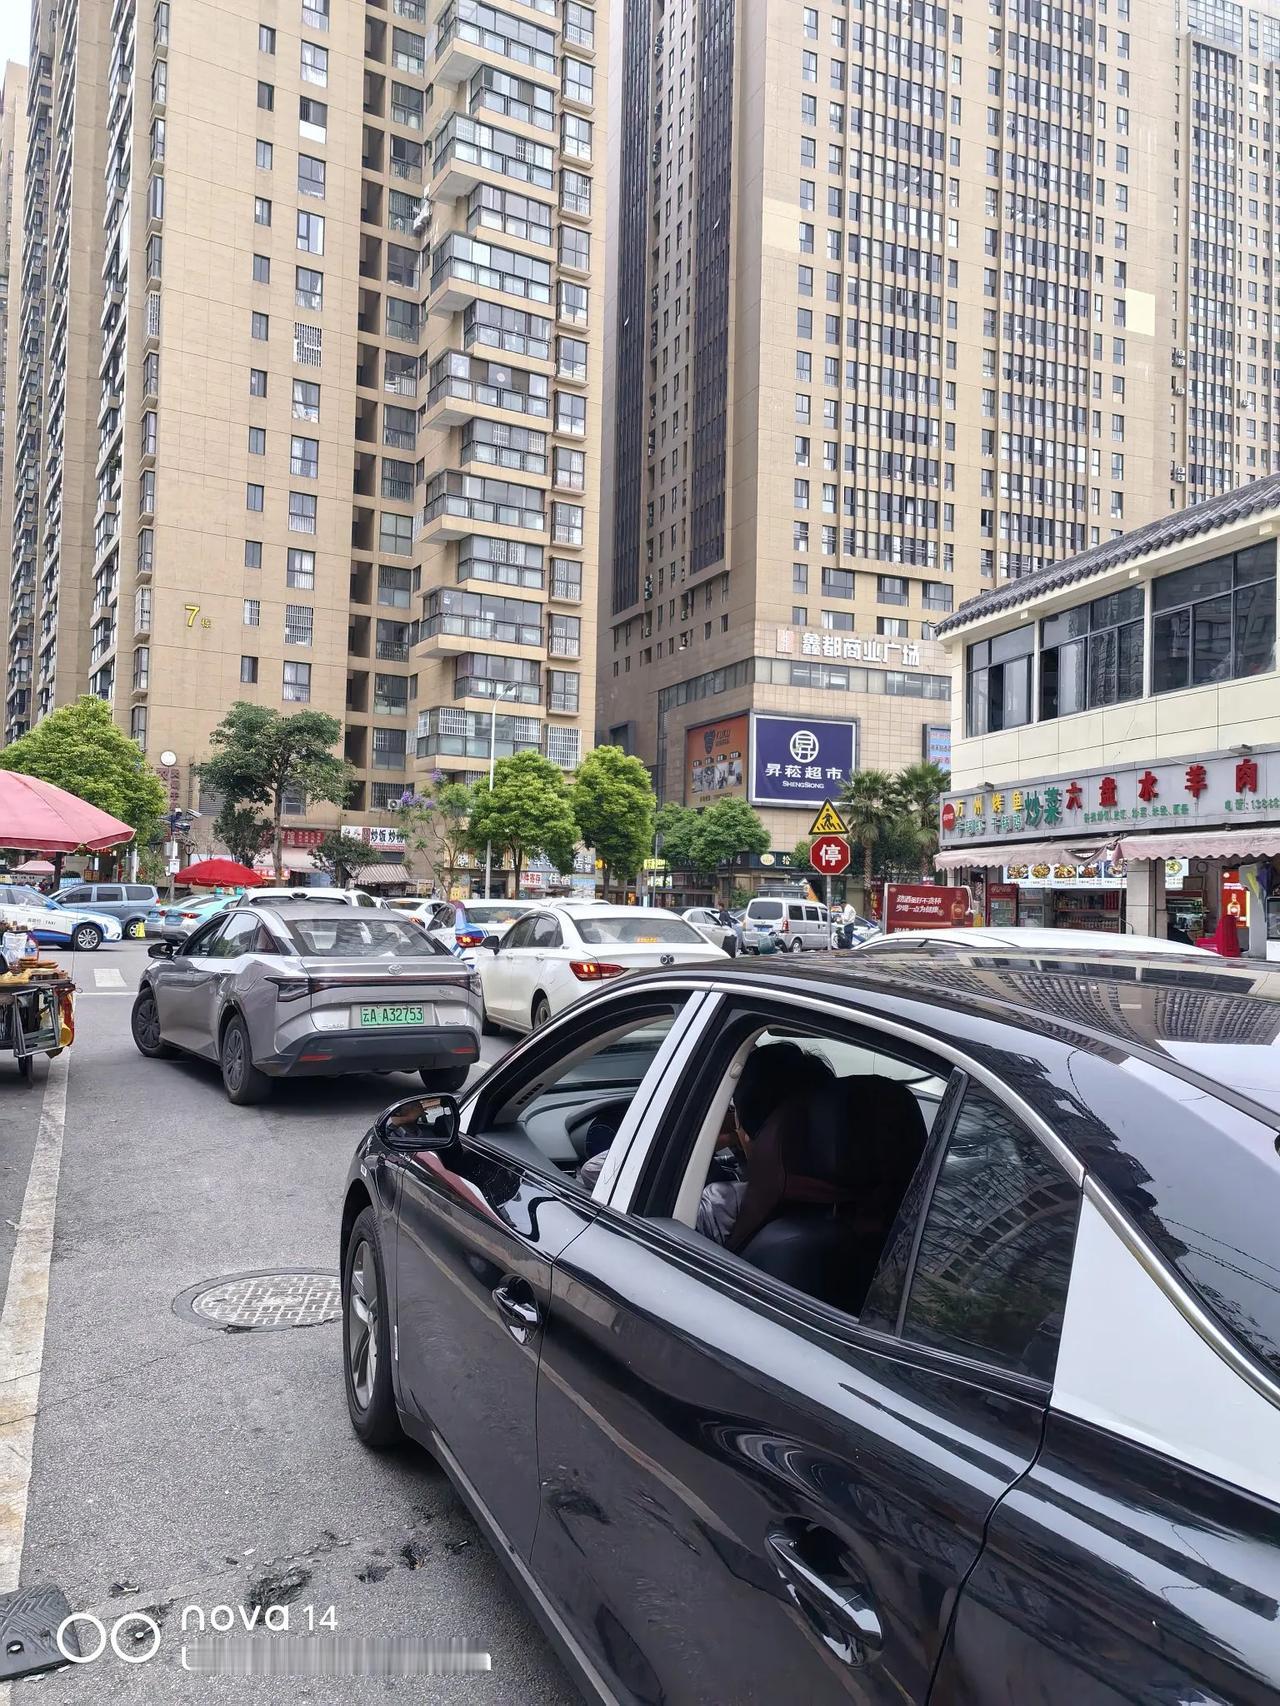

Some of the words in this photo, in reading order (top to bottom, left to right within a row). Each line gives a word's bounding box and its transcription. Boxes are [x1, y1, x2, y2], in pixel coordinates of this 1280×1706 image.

[802, 632, 920, 667] 鑫都商业广场
[765, 763, 843, 781] 昇菘超市
[1066, 758, 1258, 810] 六盘水羊肉
[1025, 787, 1061, 826] 炒菜
[819, 844, 842, 866] 停
[549, 873, 571, 886] 住宿
